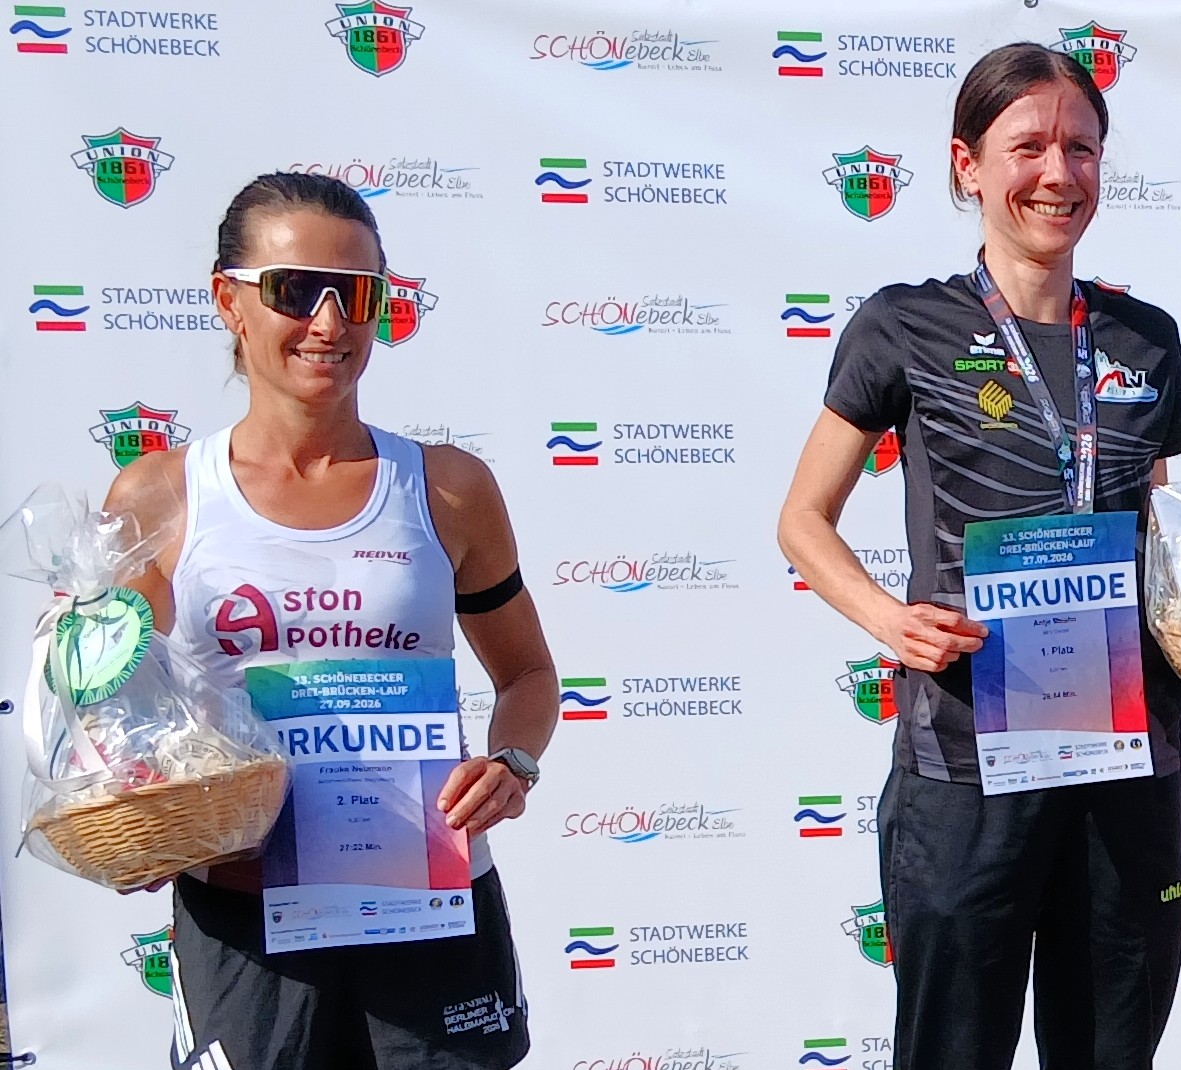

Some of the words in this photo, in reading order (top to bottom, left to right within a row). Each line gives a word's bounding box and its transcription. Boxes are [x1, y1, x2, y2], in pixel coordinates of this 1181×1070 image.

[84, 10, 218, 30] STADTWERKE
[340, 14, 410, 31] UNION
[86, 35, 220, 56] SCHÖNEBECK
[352, 29, 398, 44] 1861
[838, 35, 955, 53] STADTWERKE
[1062, 38, 1124, 53] UNION
[530, 30, 684, 62] SCHÖNebeck
[839, 58, 957, 78] SCHÖNEBECK
[85, 144, 160, 162] UNION
[99, 161, 146, 175] 1861
[603, 161, 725, 179] STADTWERKE
[835, 163, 900, 178] UNION
[848, 177, 888, 190] 1861
[605, 184, 727, 204] SCHÖNEBECK
[102, 287, 216, 305] STADTWER
[541, 296, 693, 327] SCHÖNebeck
[104, 311, 227, 331] SCHÖNEBEC
[954, 359, 1005, 371] SPORT
[103, 419, 176, 434] UNION
[614, 424, 734, 439] STADTWERKE
[117, 433, 162, 447] 1861
[615, 446, 735, 463] SCHÖNEBECK
[1018, 526, 1093, 541] SCHÖNEBECKER
[552, 555, 702, 586] SCHÖNebeck
[284, 587, 361, 614] ston
[973, 572, 1127, 612] URKUNDE
[287, 618, 420, 652] potheke
[1052, 646, 1074, 655] Platz
[313, 671, 403, 684] SCHÖNEBECKER
[623, 676, 741, 693] STADTWERKE
[848, 668, 895, 683] UNIO
[623, 699, 742, 717] SCHÖNEBECK
[278, 723, 447, 757] RKUNDE
[351, 796, 379, 806] Platz
[561, 806, 710, 837] SCHÖNebeck
[630, 923, 747, 942] STADTWERKE
[135, 940, 173, 957] UNI
[631, 946, 748, 965] SCHÖNEBECK
